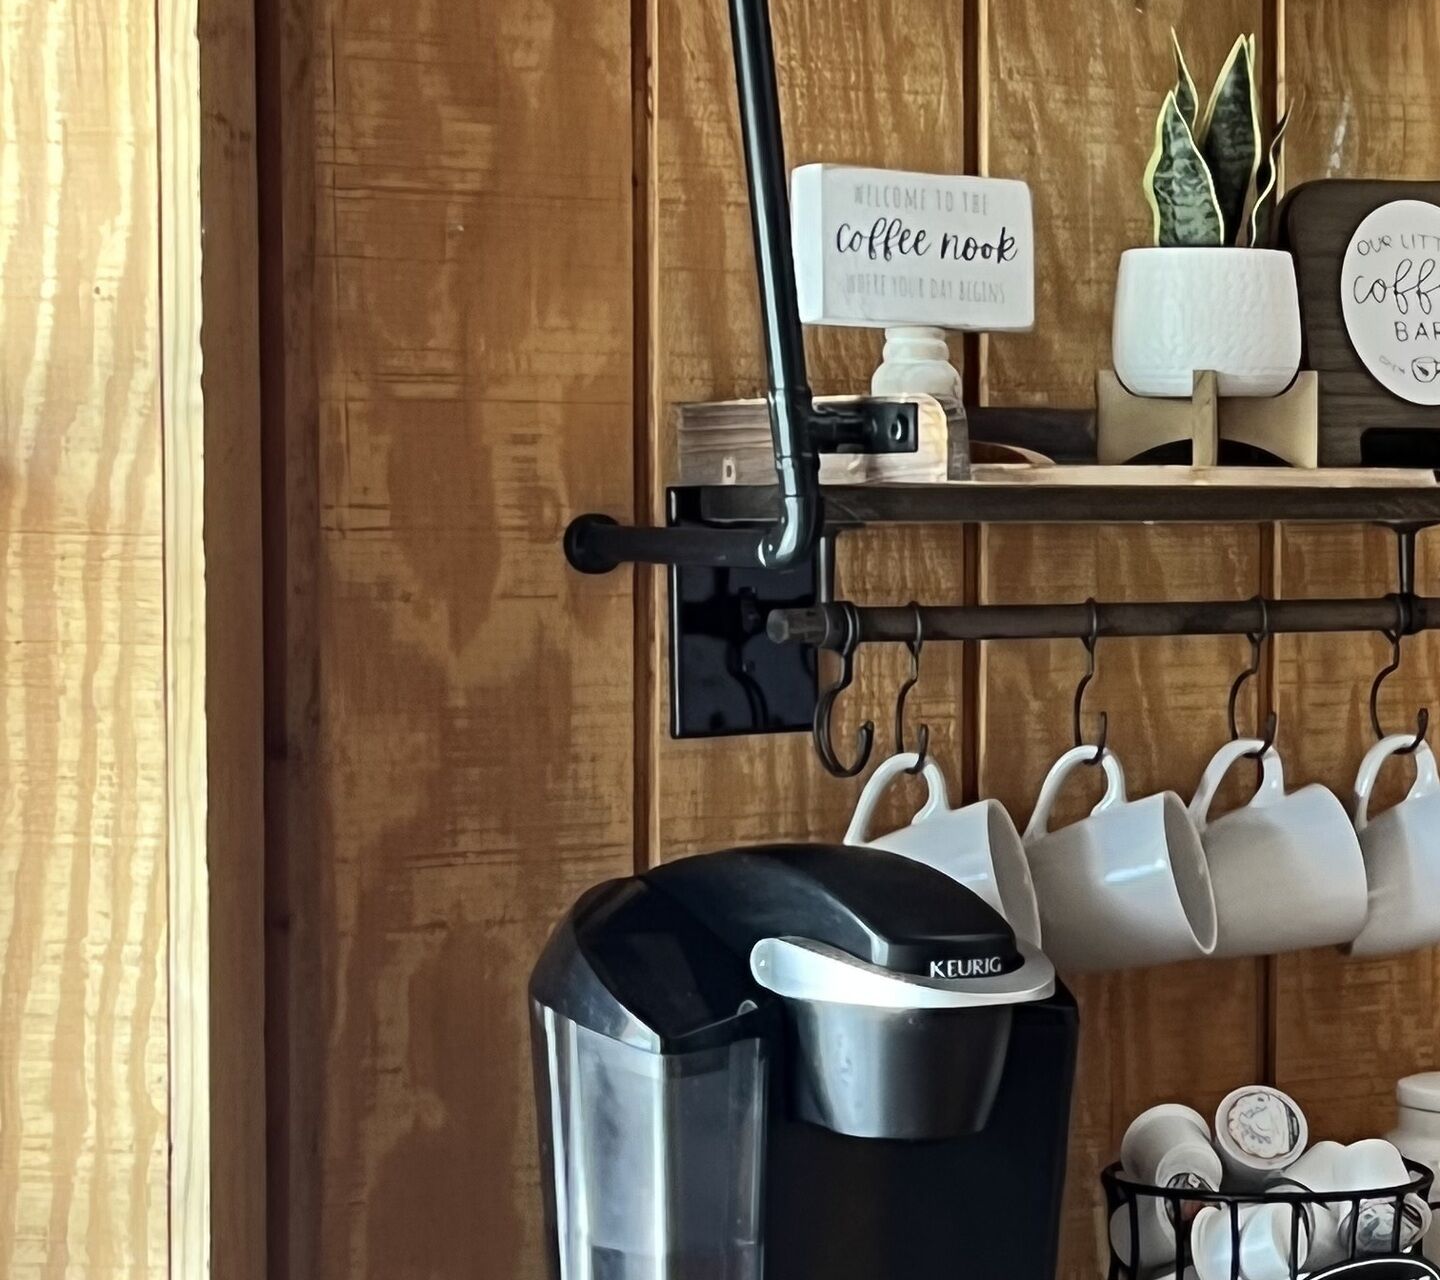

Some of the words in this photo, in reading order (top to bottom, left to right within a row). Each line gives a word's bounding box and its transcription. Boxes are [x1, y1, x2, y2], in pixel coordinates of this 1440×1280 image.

[853, 184, 927, 212] WELCOME
[936, 189, 954, 213] TO
[962, 191, 988, 216] THE
[836, 217, 932, 262] coffee
[940, 226, 1018, 264] nook
[1357, 234, 1392, 256] OUR
[930, 278, 954, 300] DAY
[958, 280, 1006, 304] BEGINS
[930, 956, 1002, 978] KEURIG
